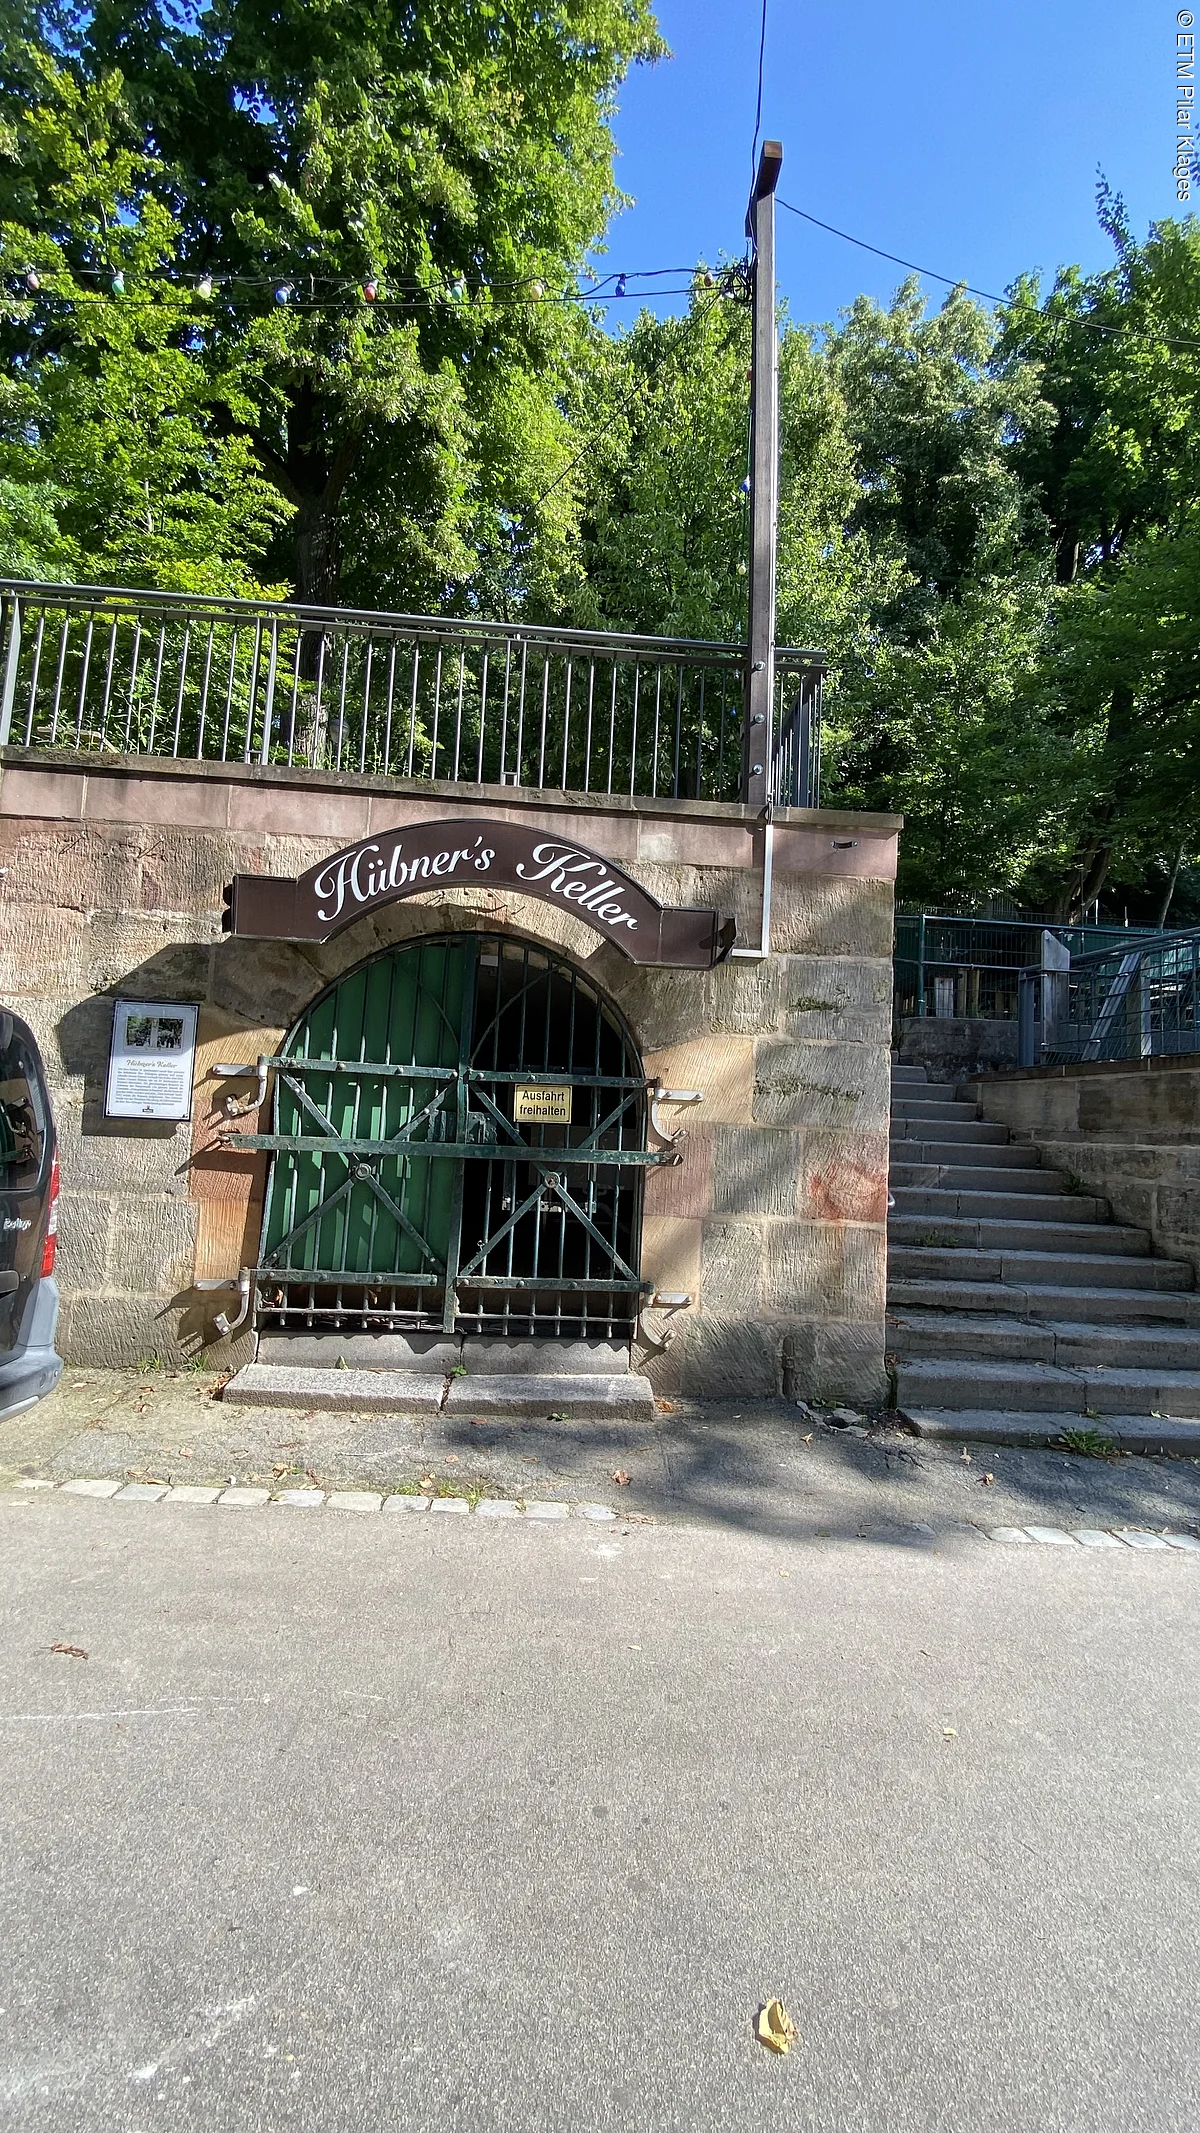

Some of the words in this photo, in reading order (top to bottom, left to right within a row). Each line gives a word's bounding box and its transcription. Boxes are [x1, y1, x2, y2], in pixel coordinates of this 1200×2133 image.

[314, 836, 496, 922] Hübner's
[516, 842, 639, 933] Keller
[522, 1090, 564, 1101] Ausfahrt
[519, 1105, 566, 1116] freihalten
